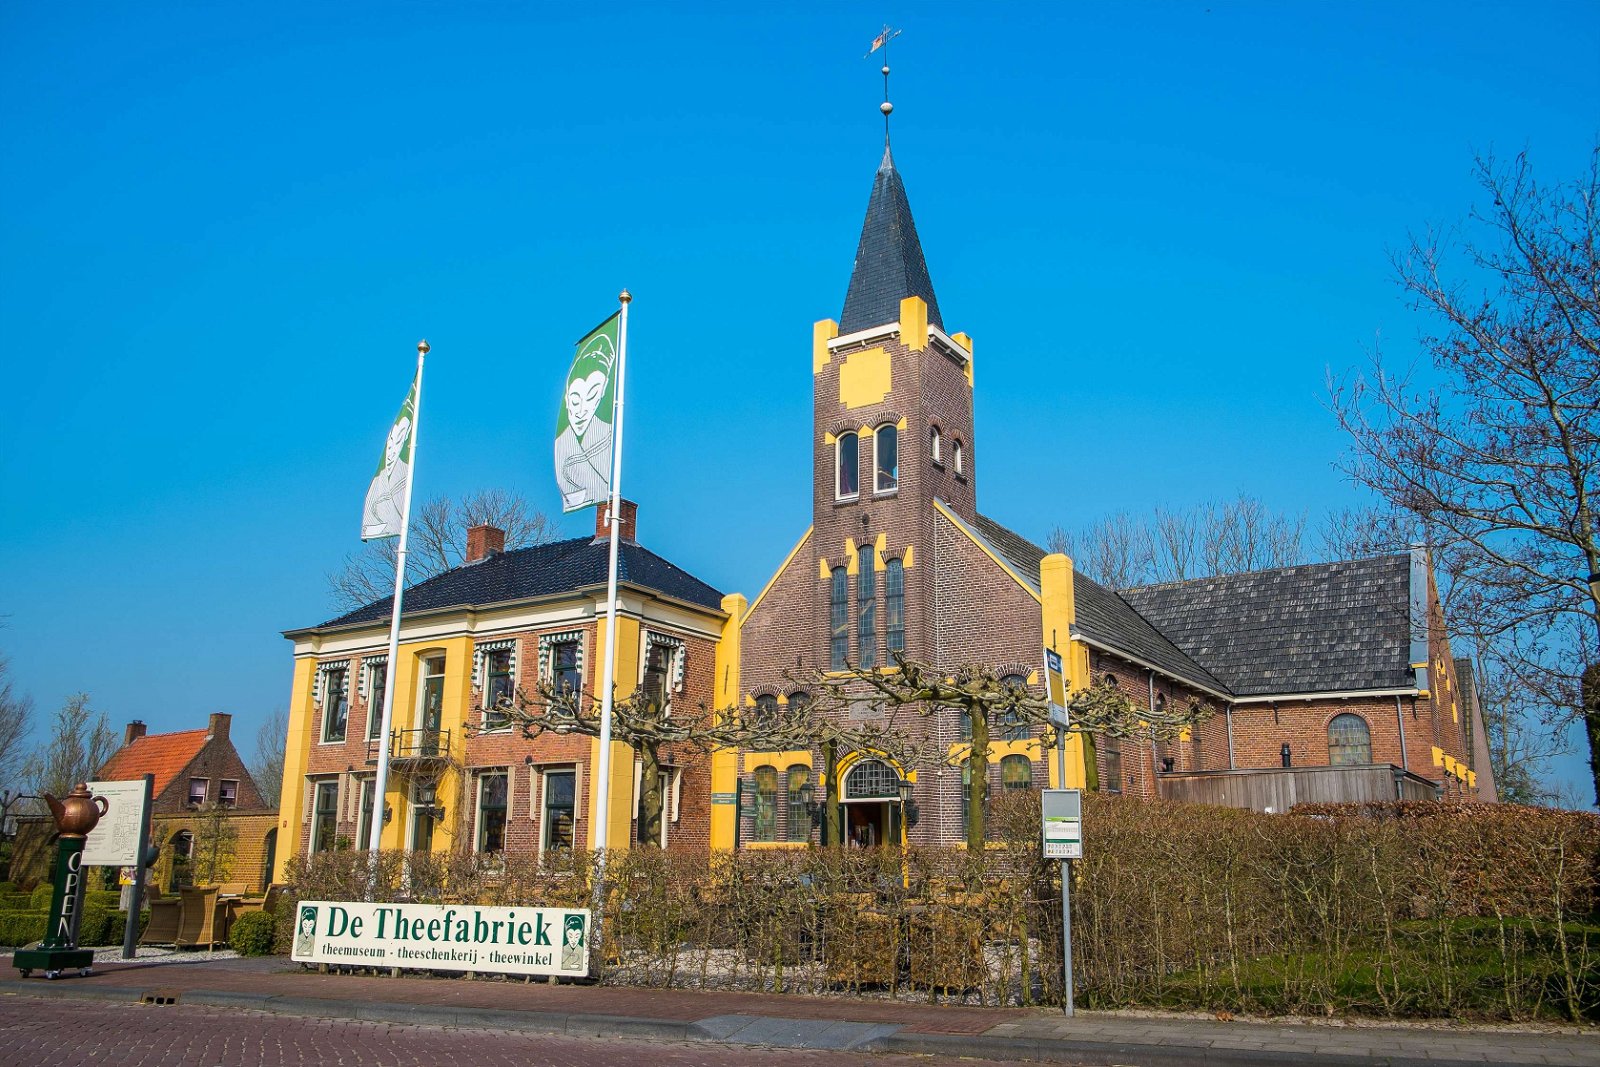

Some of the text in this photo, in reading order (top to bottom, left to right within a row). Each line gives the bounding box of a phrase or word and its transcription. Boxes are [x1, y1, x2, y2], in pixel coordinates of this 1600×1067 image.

[325, 906, 552, 946] De Theefabriek
[322, 943, 385, 957] theemuseum
[397, 946, 478, 964] theeschenkerij
[489, 950, 552, 965] theewinkel
